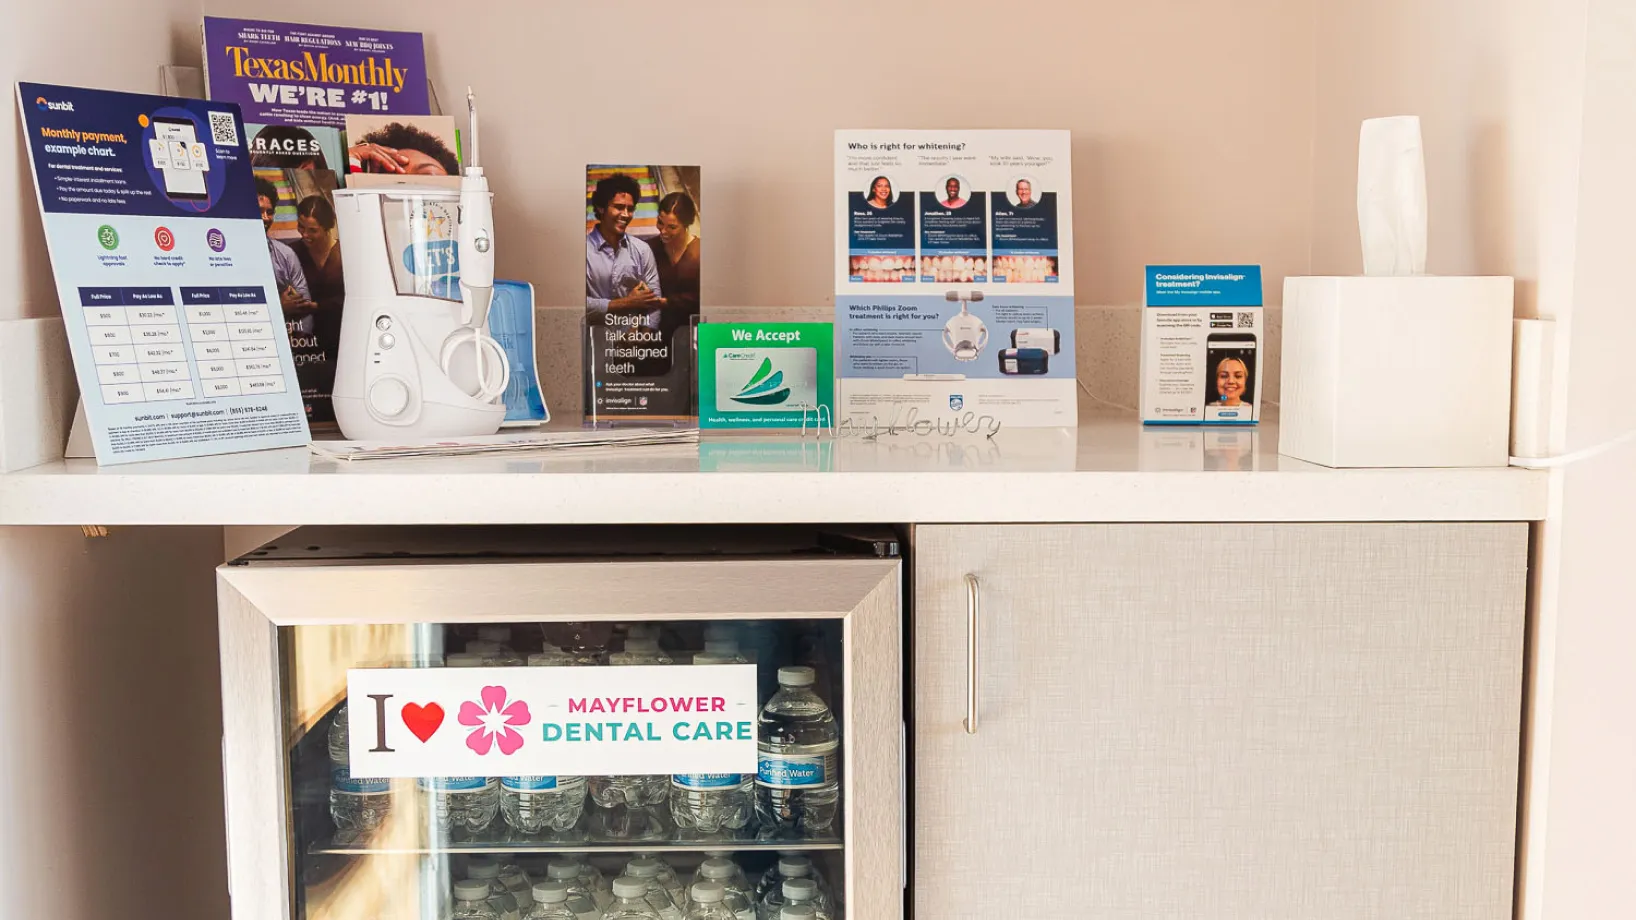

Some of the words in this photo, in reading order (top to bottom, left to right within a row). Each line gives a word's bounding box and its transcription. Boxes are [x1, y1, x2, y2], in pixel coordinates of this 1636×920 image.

[300, 37, 342, 46] REGULATIONS
[248, 82, 346, 108] WE'RE
[350, 89, 388, 110] #1!
[48, 101, 74, 111] sunbit
[41, 127, 80, 142] Monthly
[82, 131, 128, 144] payment,
[45, 144, 86, 157] example
[248, 138, 320, 151] RACES
[880, 142, 900, 151] right
[918, 142, 966, 151] whitening?
[605, 313, 650, 328] Straight
[290, 336, 318, 348] bout
[605, 330, 626, 341] talk
[628, 330, 662, 341] about
[732, 329, 752, 341] We
[756, 329, 800, 343] Accept
[605, 346, 668, 360] misaligned
[605, 362, 634, 373] teeth
[171, 410, 224, 419] support@sunbit.com
[568, 696, 726, 713] MAYFLOWER
[367, 694, 395, 752] I
[542, 722, 661, 742] DENTAL
[672, 721, 752, 741] CARE
